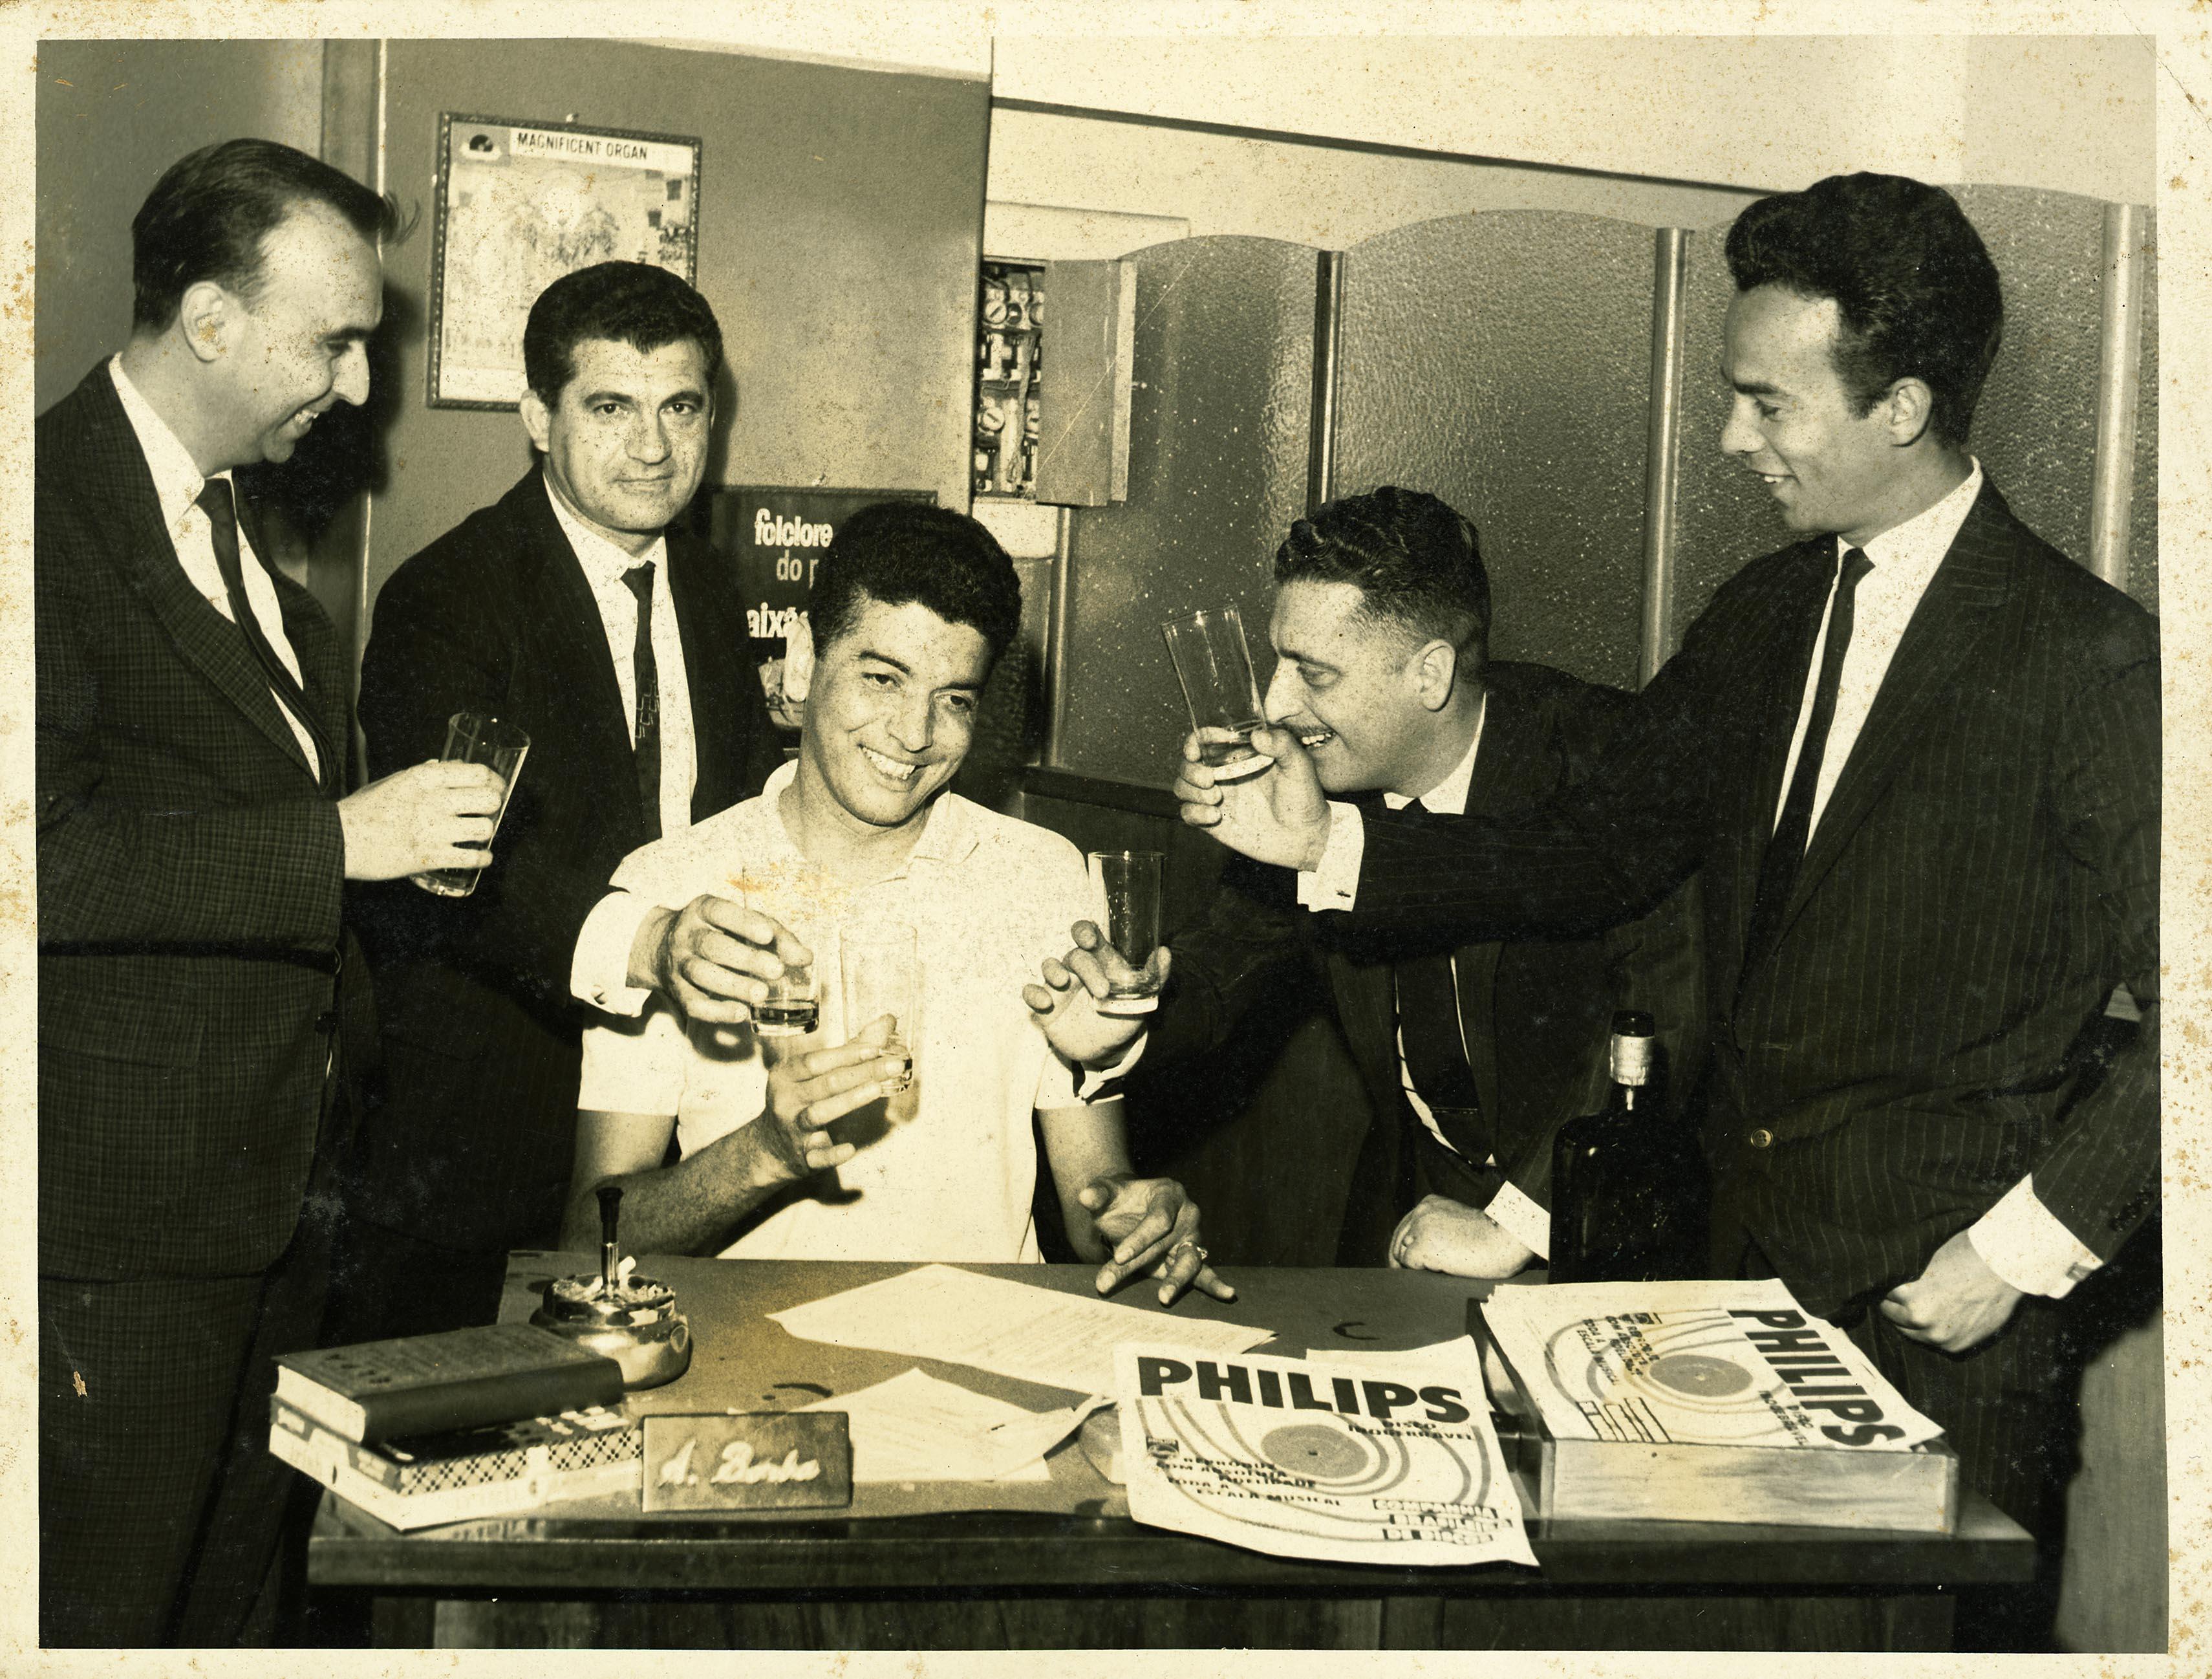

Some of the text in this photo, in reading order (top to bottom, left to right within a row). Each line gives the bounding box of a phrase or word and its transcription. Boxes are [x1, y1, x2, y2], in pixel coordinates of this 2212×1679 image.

[517, 132, 647, 160] MAGNIFICENT ORGAN
[755, 508, 833, 547] folclore
[776, 549, 802, 581] do
[1137, 1356, 1470, 1423] PHILIPS
[1727, 1310, 1906, 1446] PHILIPS
